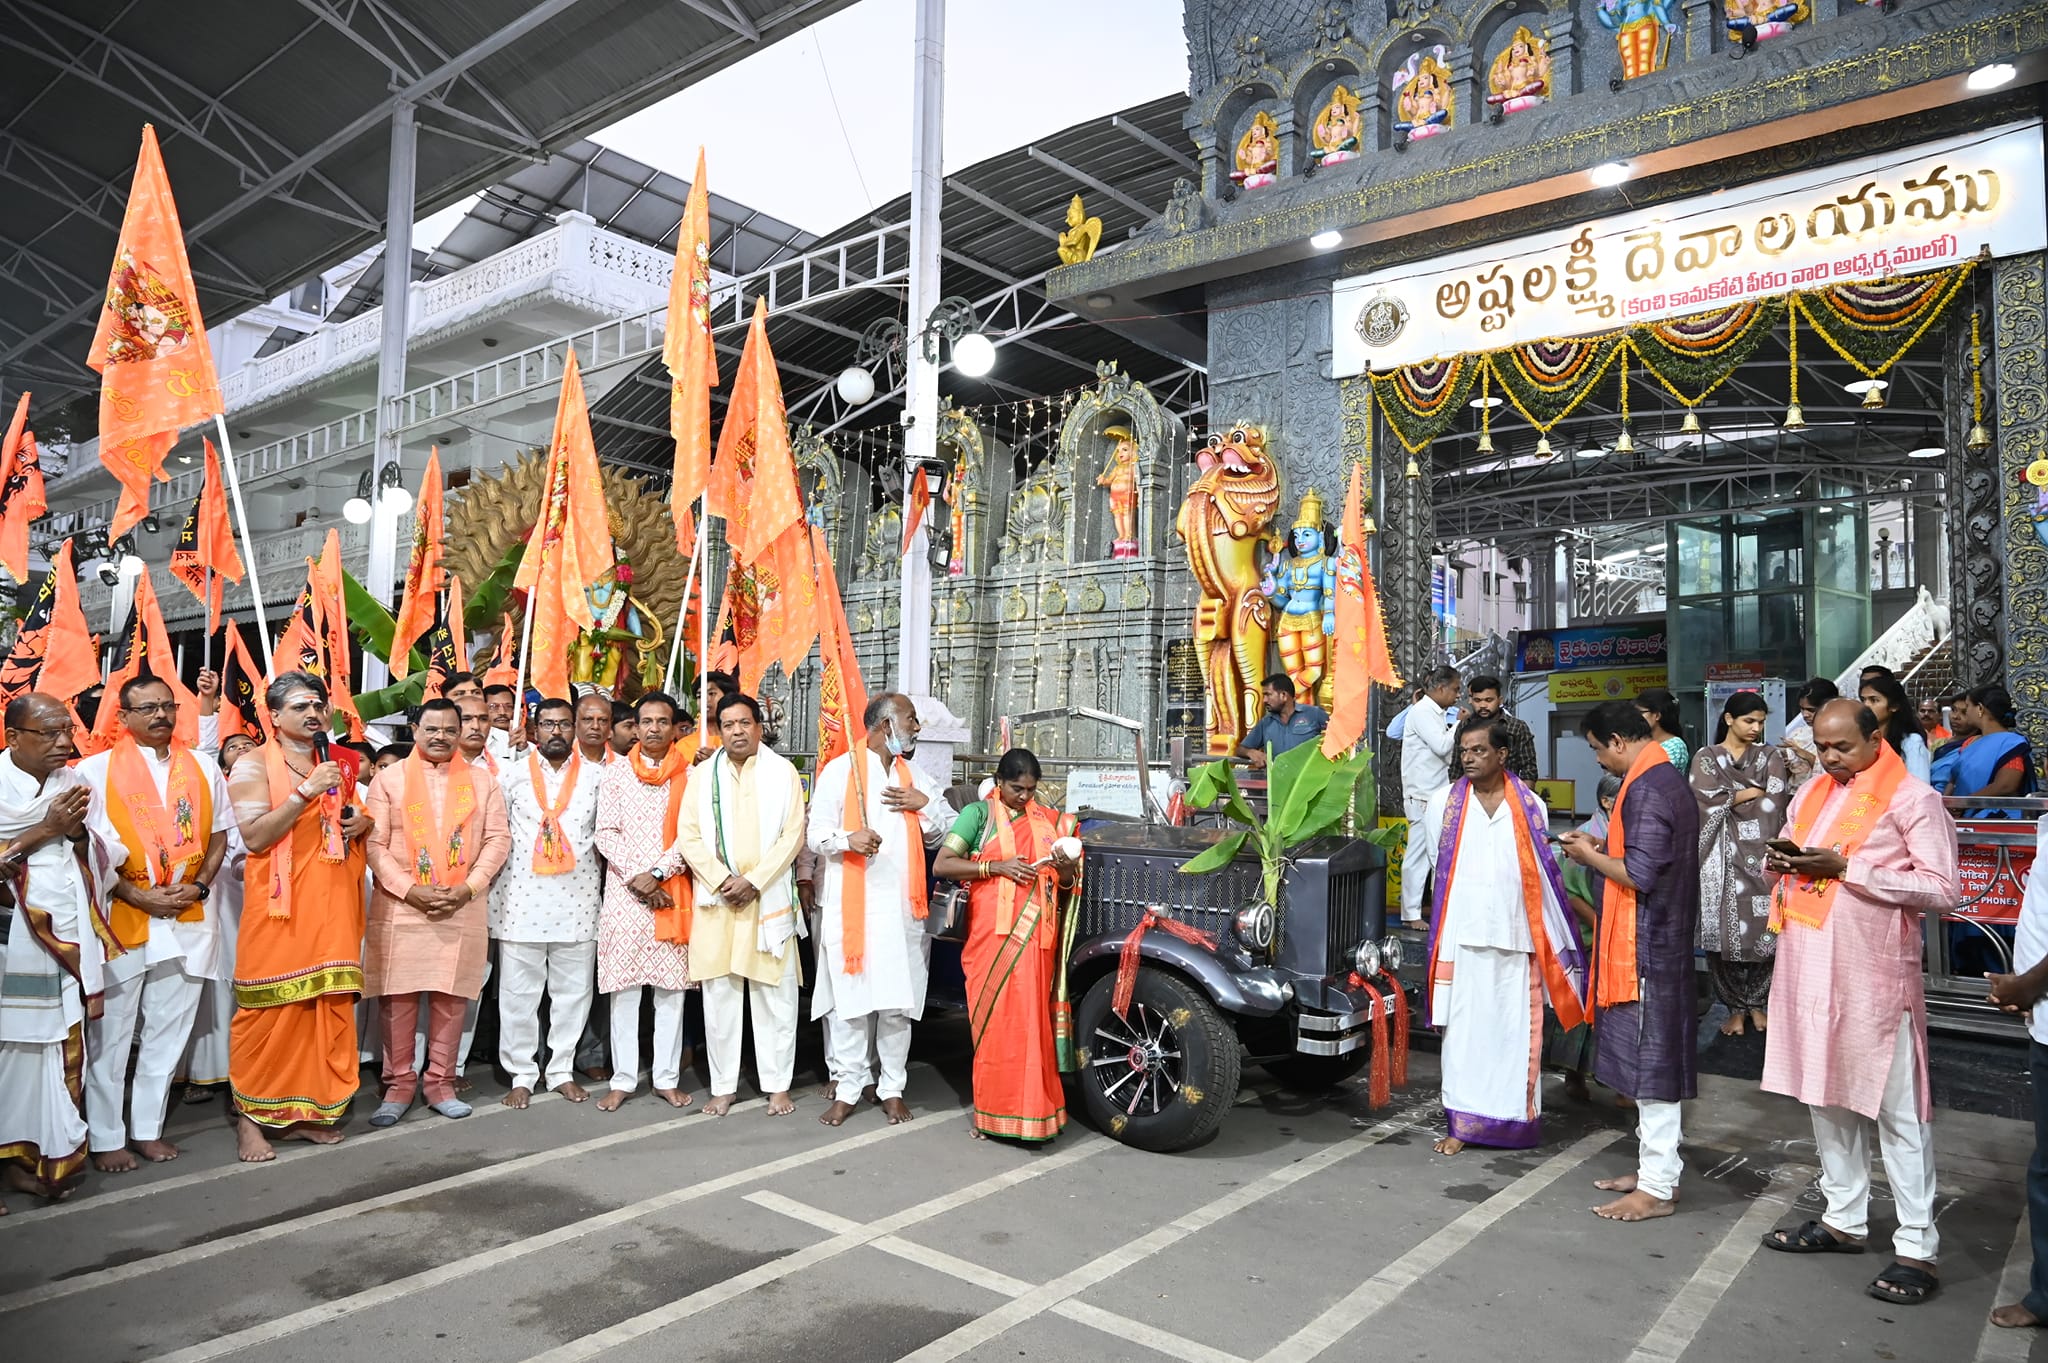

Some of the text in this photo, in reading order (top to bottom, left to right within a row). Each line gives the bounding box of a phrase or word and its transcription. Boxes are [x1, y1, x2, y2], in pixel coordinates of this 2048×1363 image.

[1436, 228, 1616, 333] అష్టలక్ష్మీ
[1624, 164, 2001, 283] దేవాలయము
[1669, 276, 1744, 307] కామకోటి
[1747, 269, 1788, 293] పీఠం
[1791, 262, 1830, 282] వారి
[1981, 896, 2018, 906] PHONES
